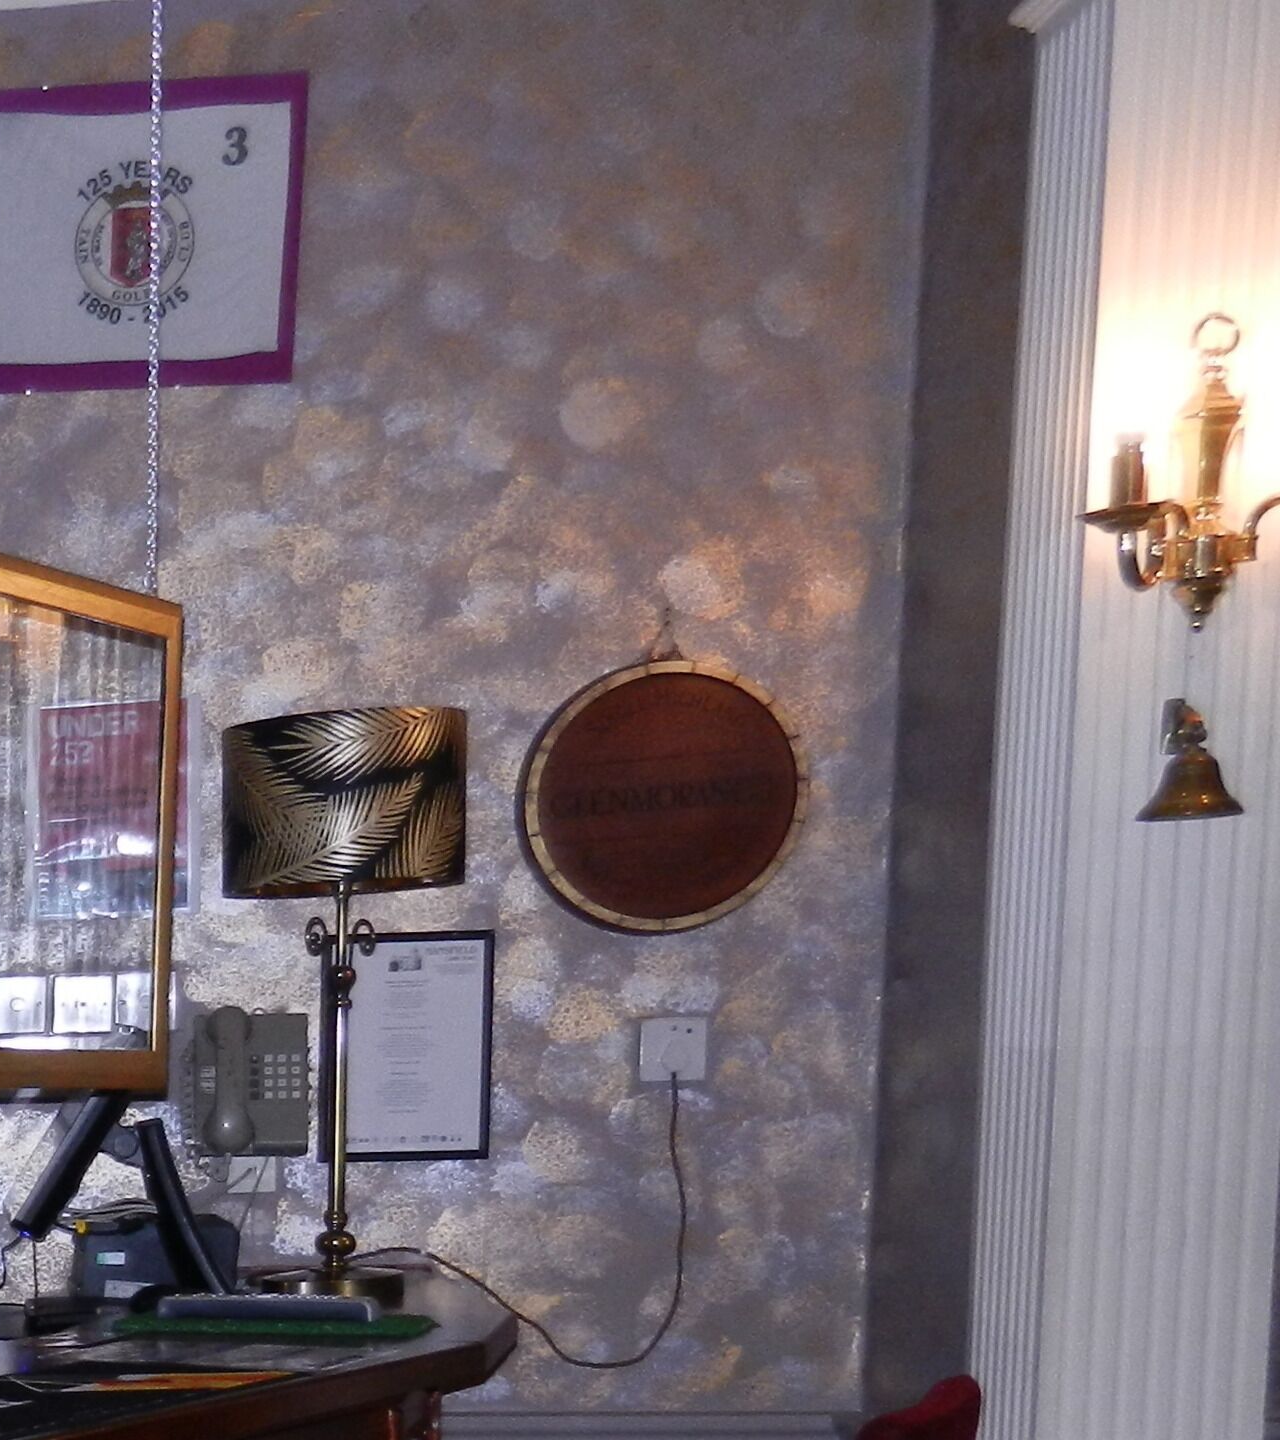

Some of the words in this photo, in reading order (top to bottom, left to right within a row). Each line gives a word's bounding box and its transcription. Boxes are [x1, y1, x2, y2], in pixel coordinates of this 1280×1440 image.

[221, 126, 248, 166] 3
[77, 169, 113, 202] 125
[78, 291, 123, 325] 1890
[47, 710, 139, 738] UNDER
